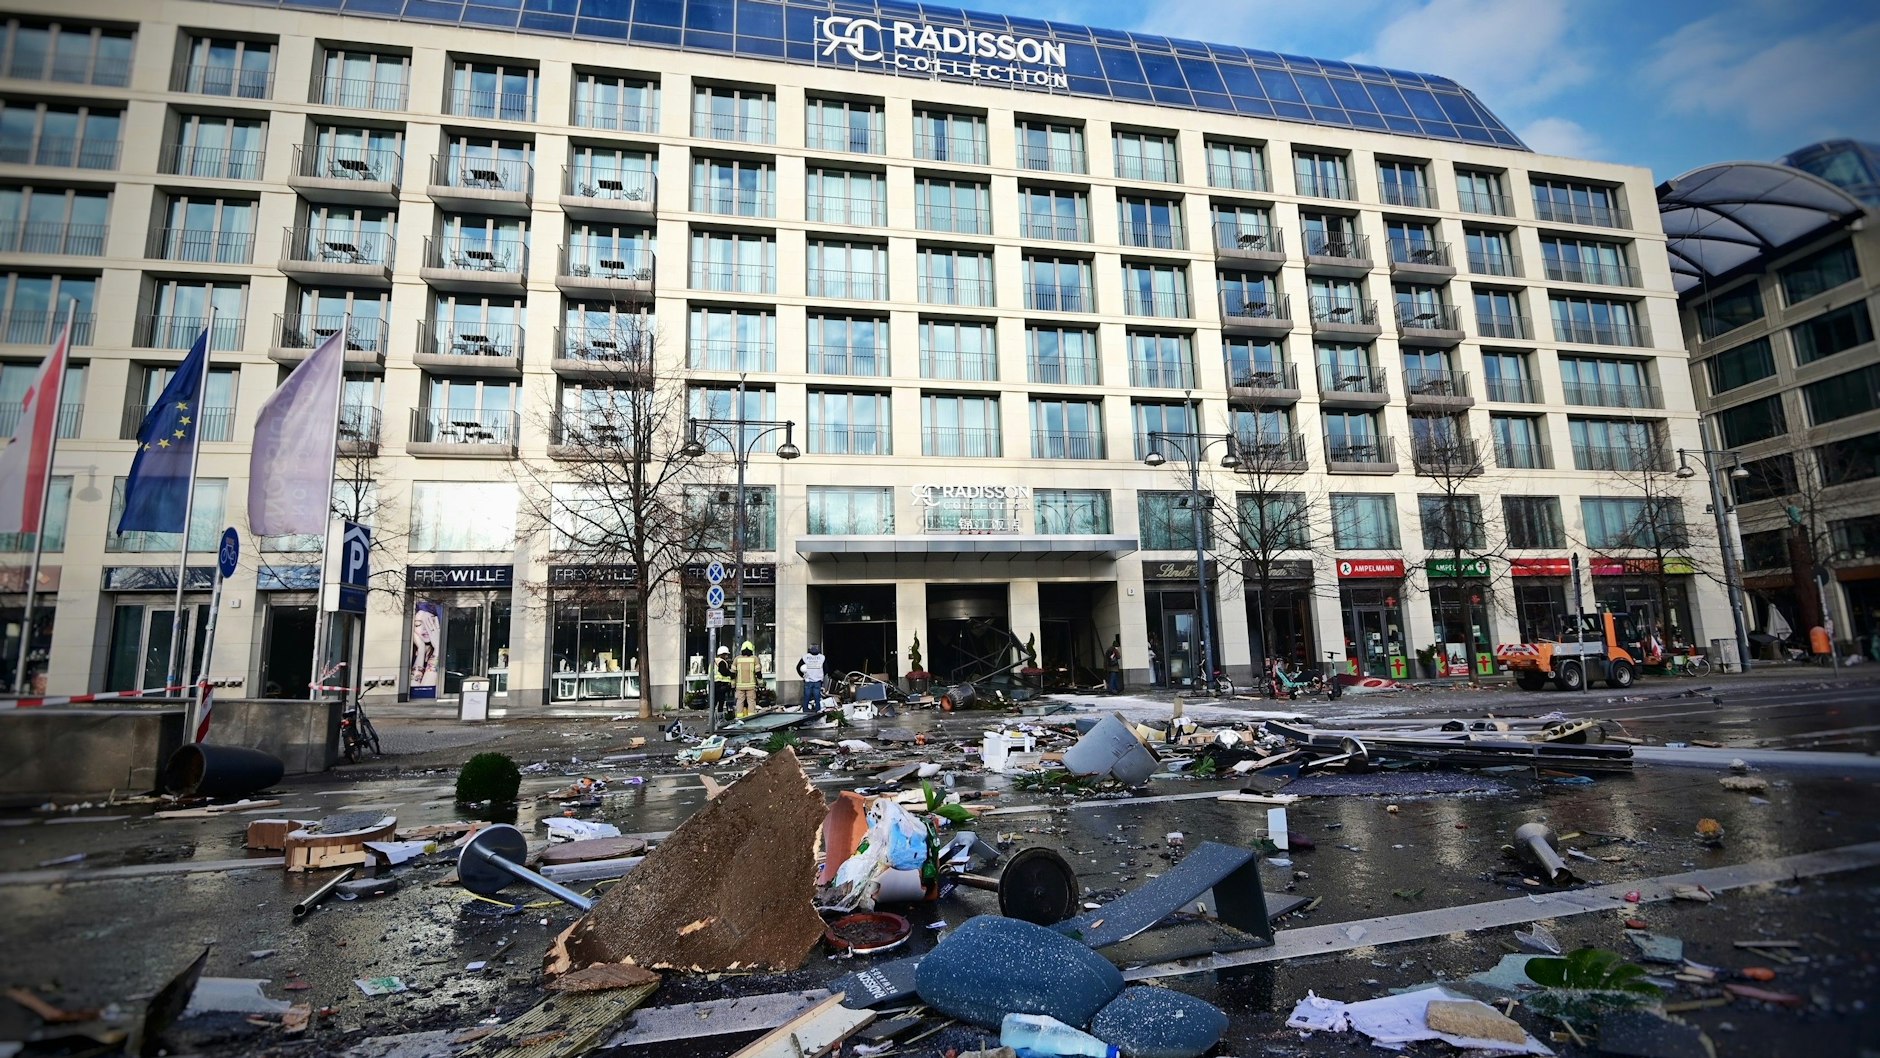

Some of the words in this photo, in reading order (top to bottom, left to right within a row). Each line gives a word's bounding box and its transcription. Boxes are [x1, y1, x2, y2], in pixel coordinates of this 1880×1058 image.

[893, 21, 1067, 68] RADISSON
[894, 54, 1069, 88] COLLECTION
[943, 485, 1030, 498] RADISSON
[348, 540, 365, 584] P
[1156, 562, 1194, 578] Lindt
[1354, 564, 1395, 573] AMPELMANN
[414, 569, 505, 583] FREYWILLE
[856, 971, 887, 999] RADISSON
[870, 967, 898, 994] REWARDS
